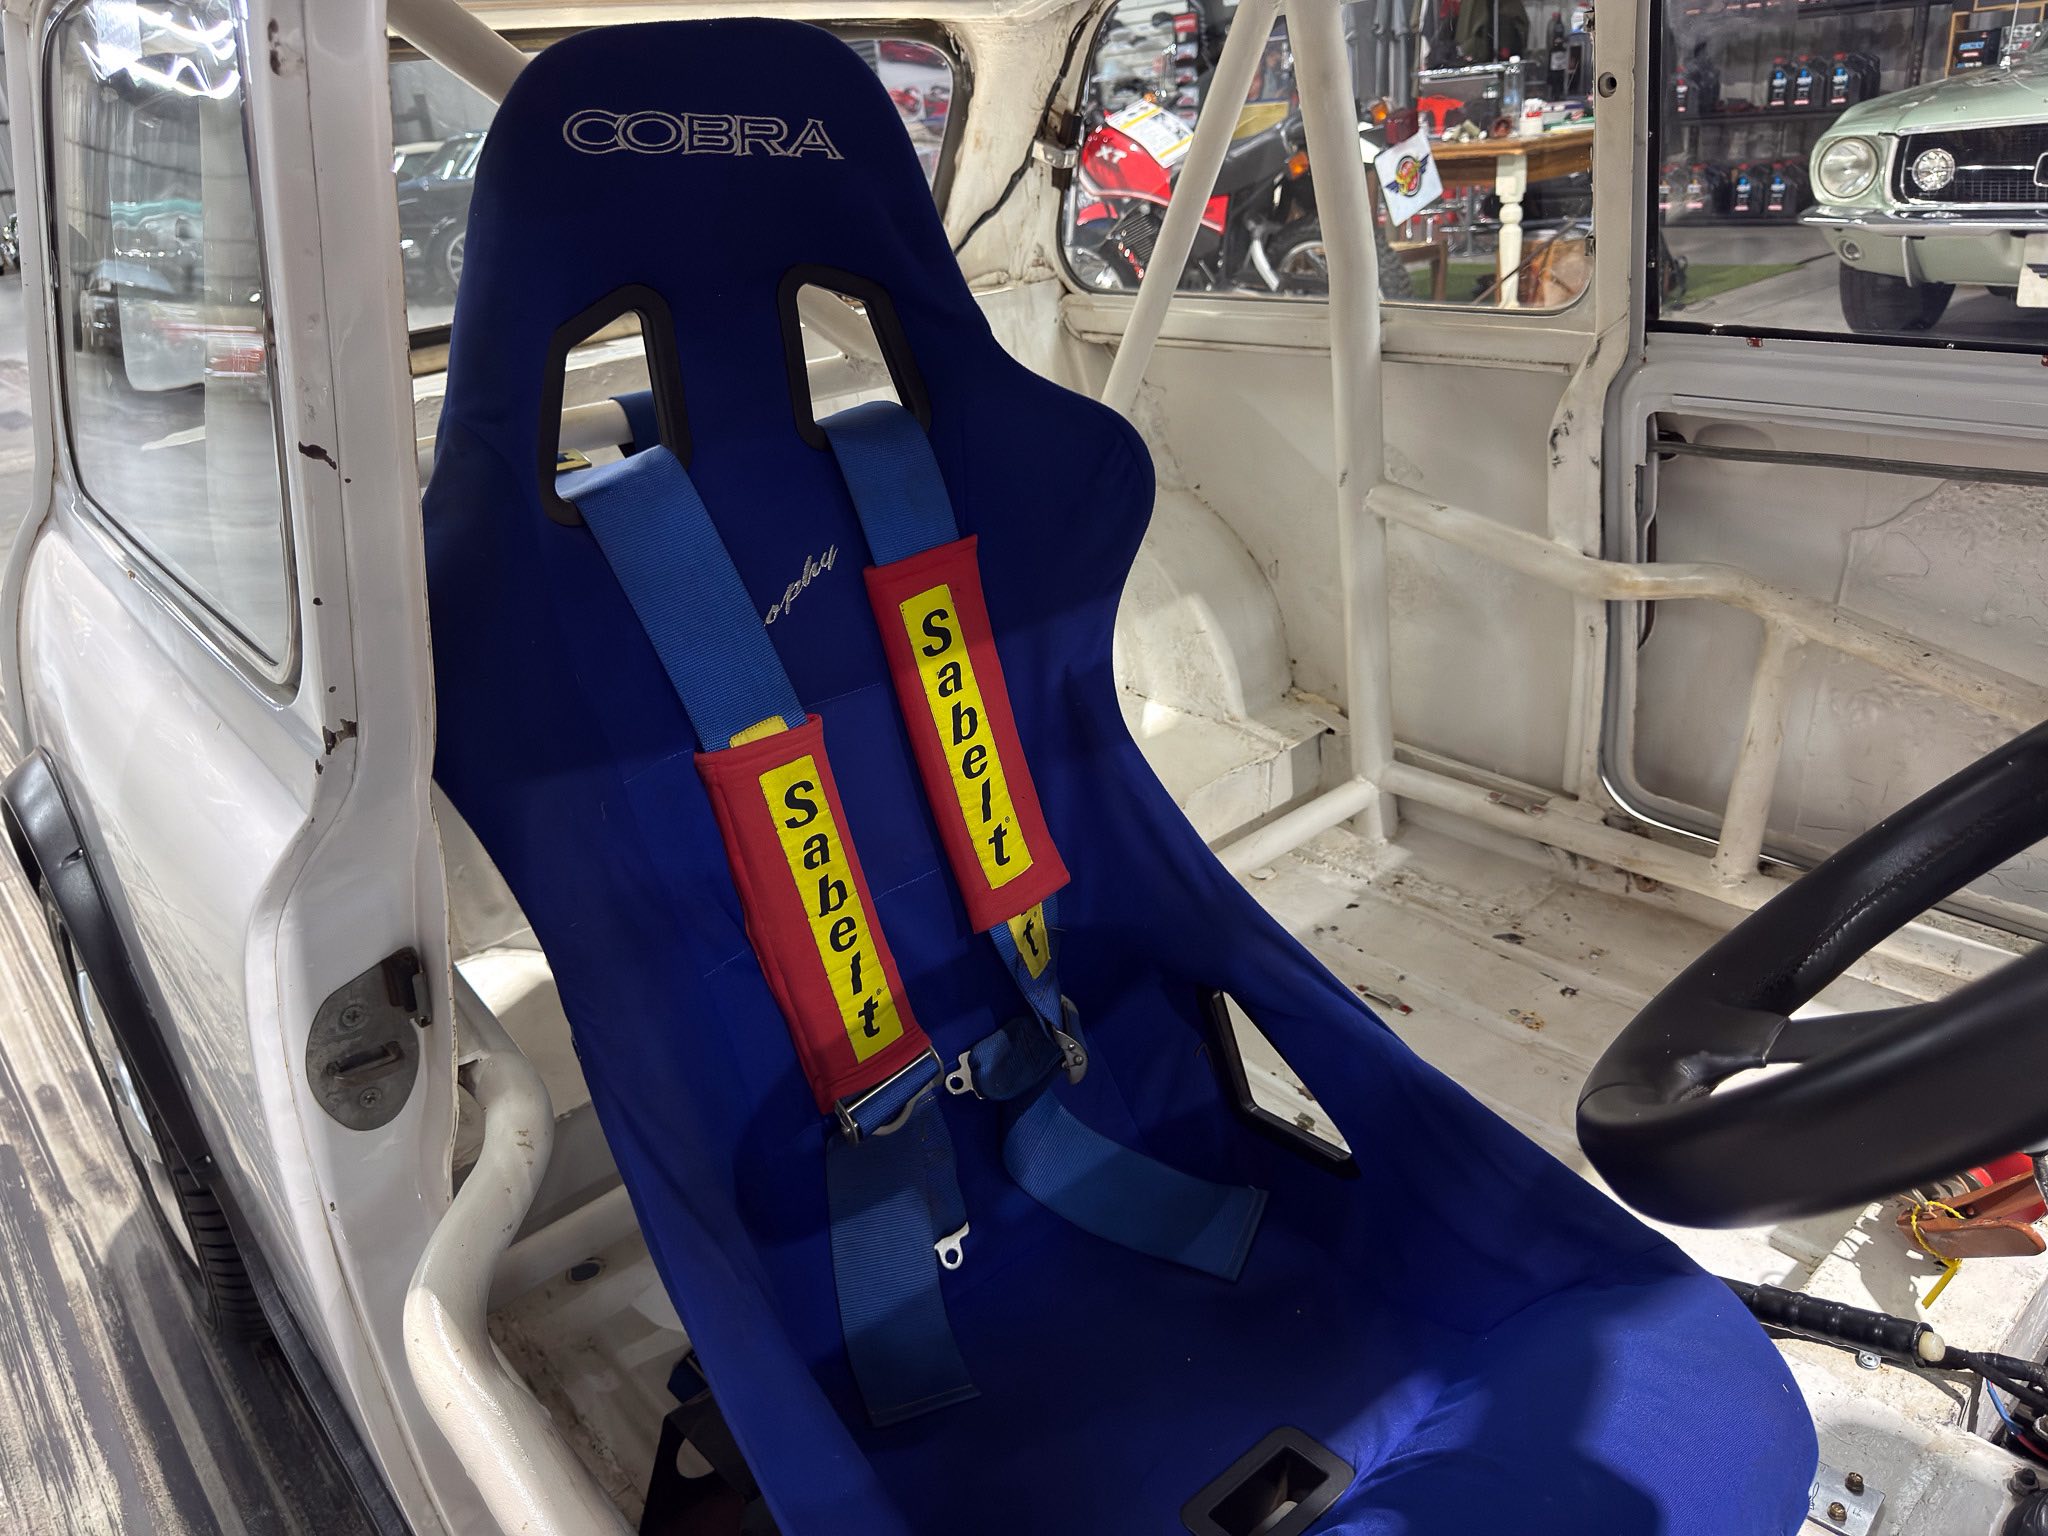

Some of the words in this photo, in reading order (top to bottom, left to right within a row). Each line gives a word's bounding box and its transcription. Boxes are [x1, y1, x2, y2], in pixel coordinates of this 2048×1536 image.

[563, 109, 845, 160] COBRA
[764, 544, 839, 627] ophy
[922, 609, 1013, 866] Sabelt
[784, 781, 881, 1038] Sabelt
